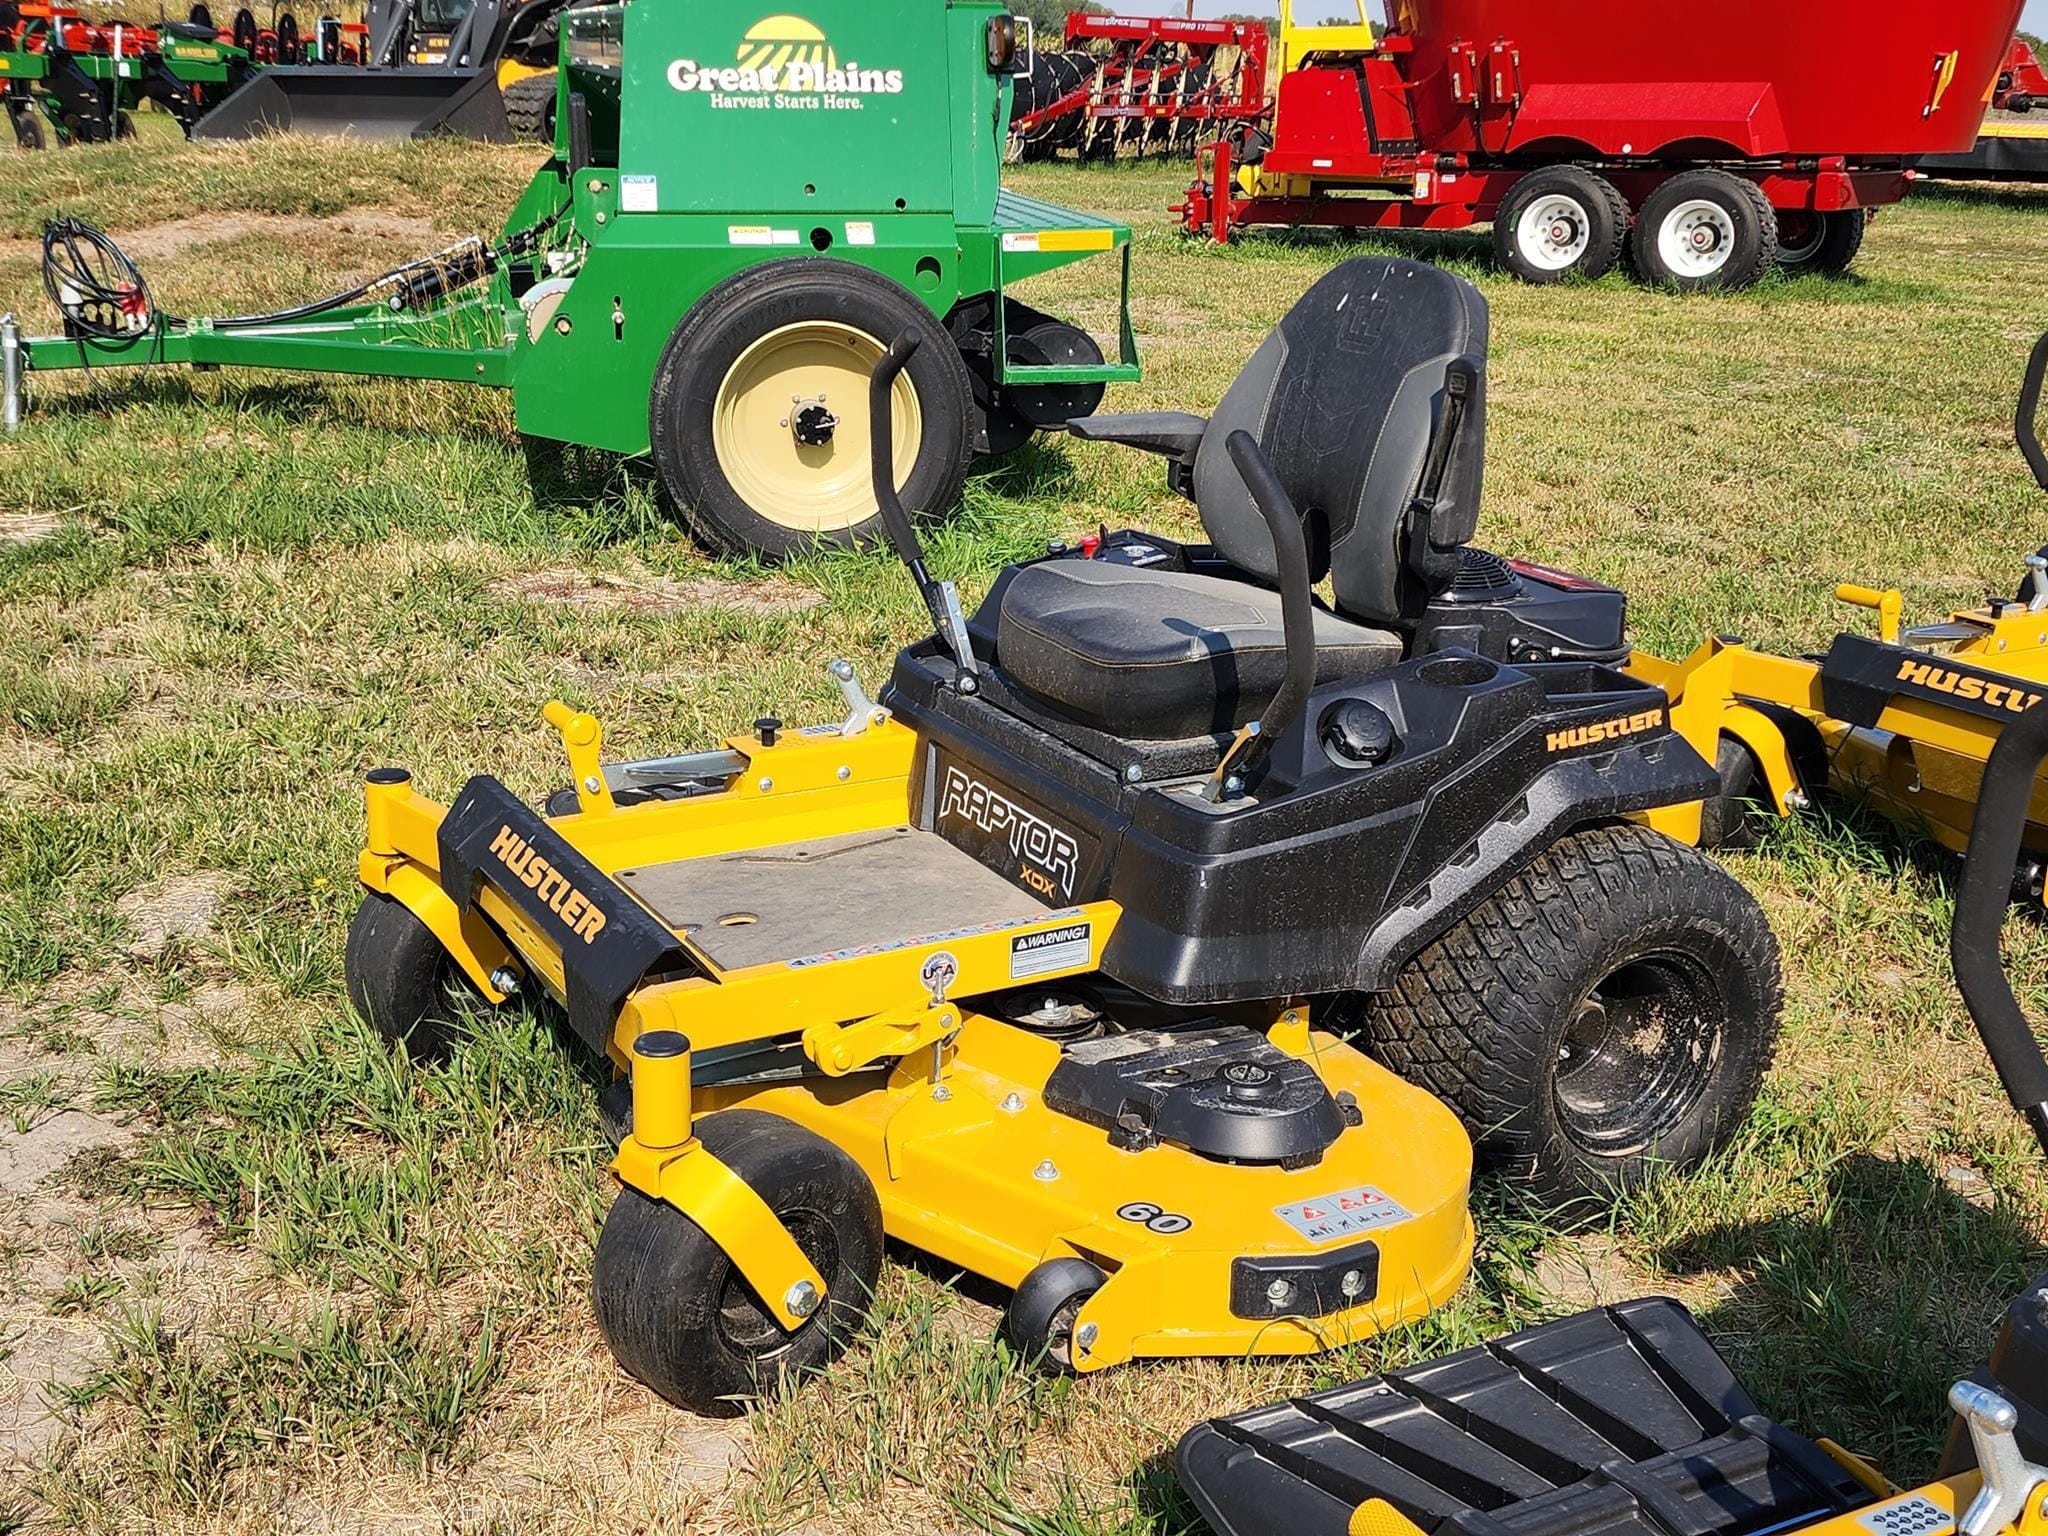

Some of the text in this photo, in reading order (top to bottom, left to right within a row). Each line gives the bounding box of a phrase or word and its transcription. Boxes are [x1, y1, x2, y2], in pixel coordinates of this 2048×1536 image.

[667, 59, 903, 93] Great Plains
[710, 93, 864, 109] Harvest Starts Here.
[1545, 708, 1663, 752] HUSTLER
[939, 766, 1078, 900] RAPTOR
[489, 824, 606, 945] HUSTLER
[1028, 926, 1086, 948] WARNING!
[1116, 1202, 1192, 1234] 60
